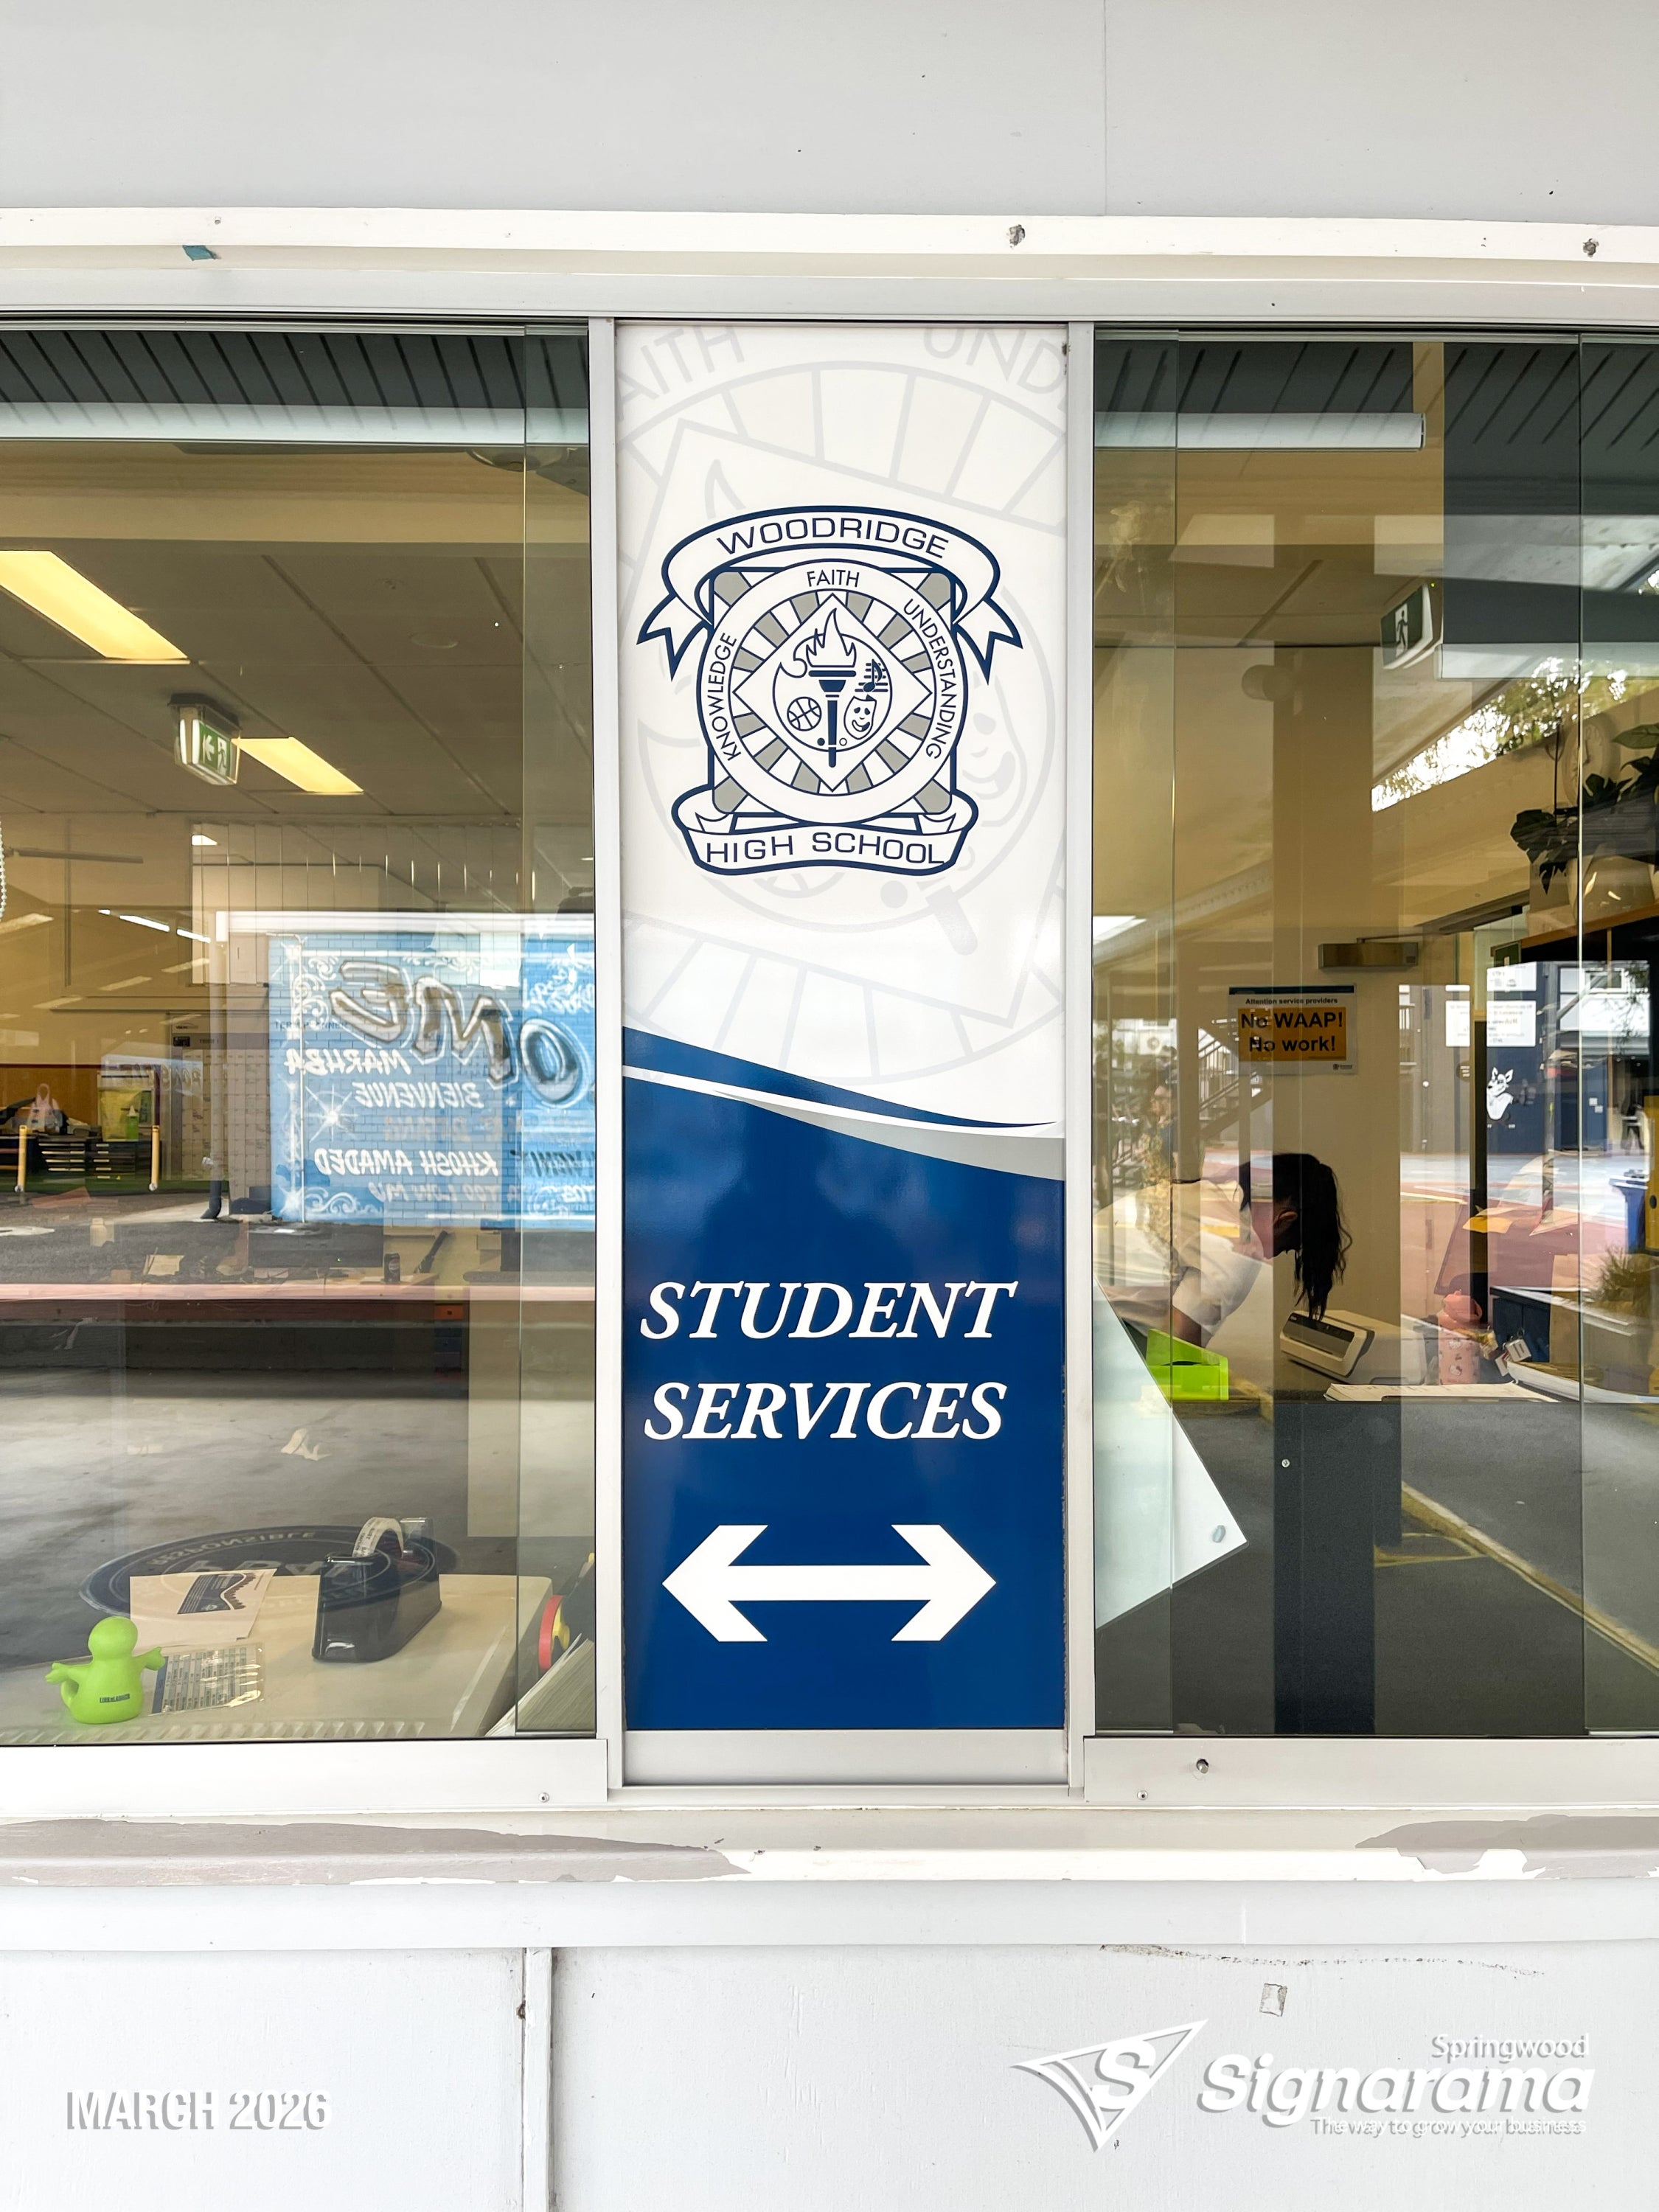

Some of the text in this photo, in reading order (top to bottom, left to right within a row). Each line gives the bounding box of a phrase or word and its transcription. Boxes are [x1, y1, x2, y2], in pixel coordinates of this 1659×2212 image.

[922, 325, 1067, 414] UND
[717, 518, 950, 559] WOODRIDGE
[807, 569, 860, 588] FAITH
[707, 632, 742, 762] KNOWLEDGE
[903, 598, 959, 760] UNDERSTANDING
[706, 832, 945, 864] HIGH SCHOOL
[1241, 1012, 1343, 1029] No WAAP!
[1305, 997, 1338, 1005] providers
[1248, 1035, 1336, 1052] No work!
[640, 1280, 1019, 1340] STUDENT
[644, 1381, 1008, 1440] SERVICES
